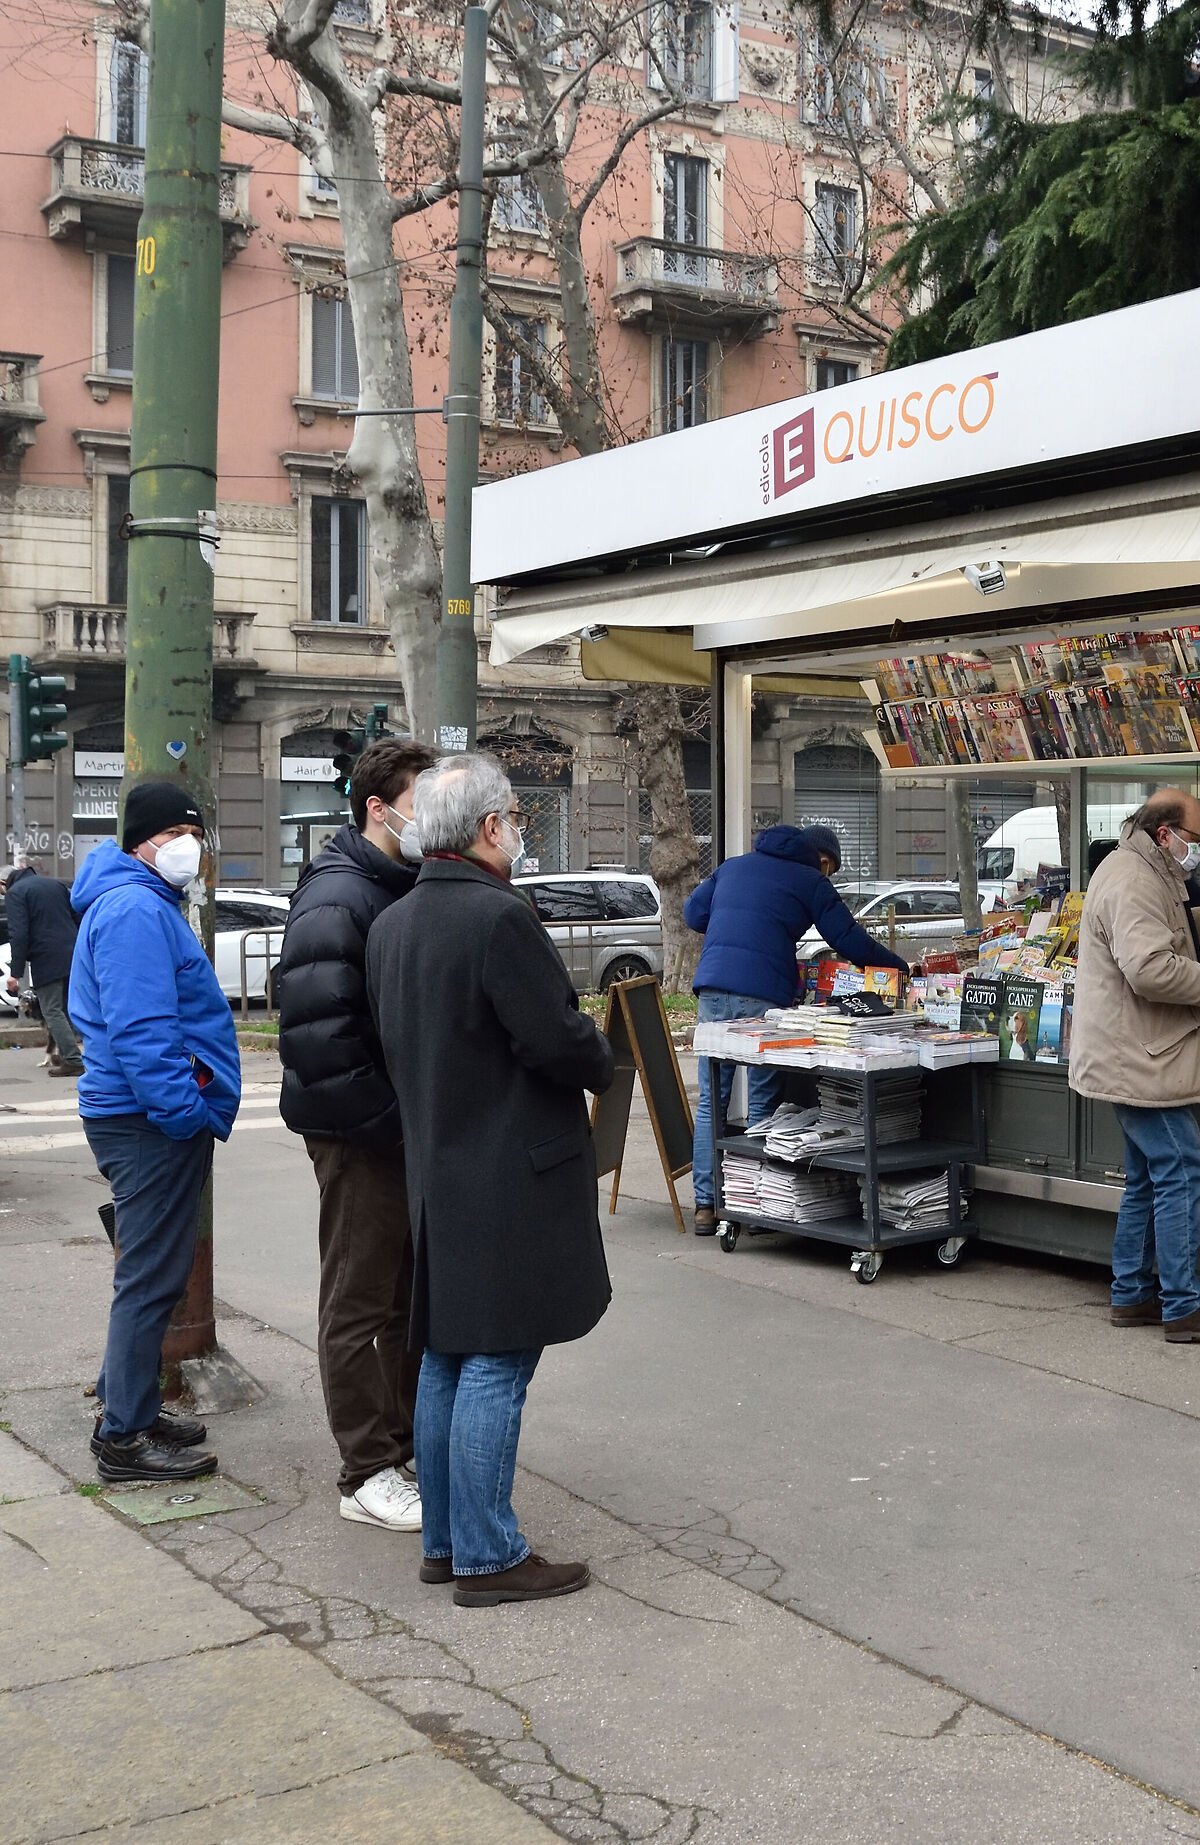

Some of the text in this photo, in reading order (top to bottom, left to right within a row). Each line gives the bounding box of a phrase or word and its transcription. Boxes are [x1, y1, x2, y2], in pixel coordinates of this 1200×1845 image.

[759, 433, 770, 506] edicola
[448, 600, 471, 615] 5769
[987, 701, 1016, 713] ASTRA
[294, 765, 319, 776] Hair
[966, 990, 997, 1005] GATTO
[1008, 992, 1034, 1007] CANE
